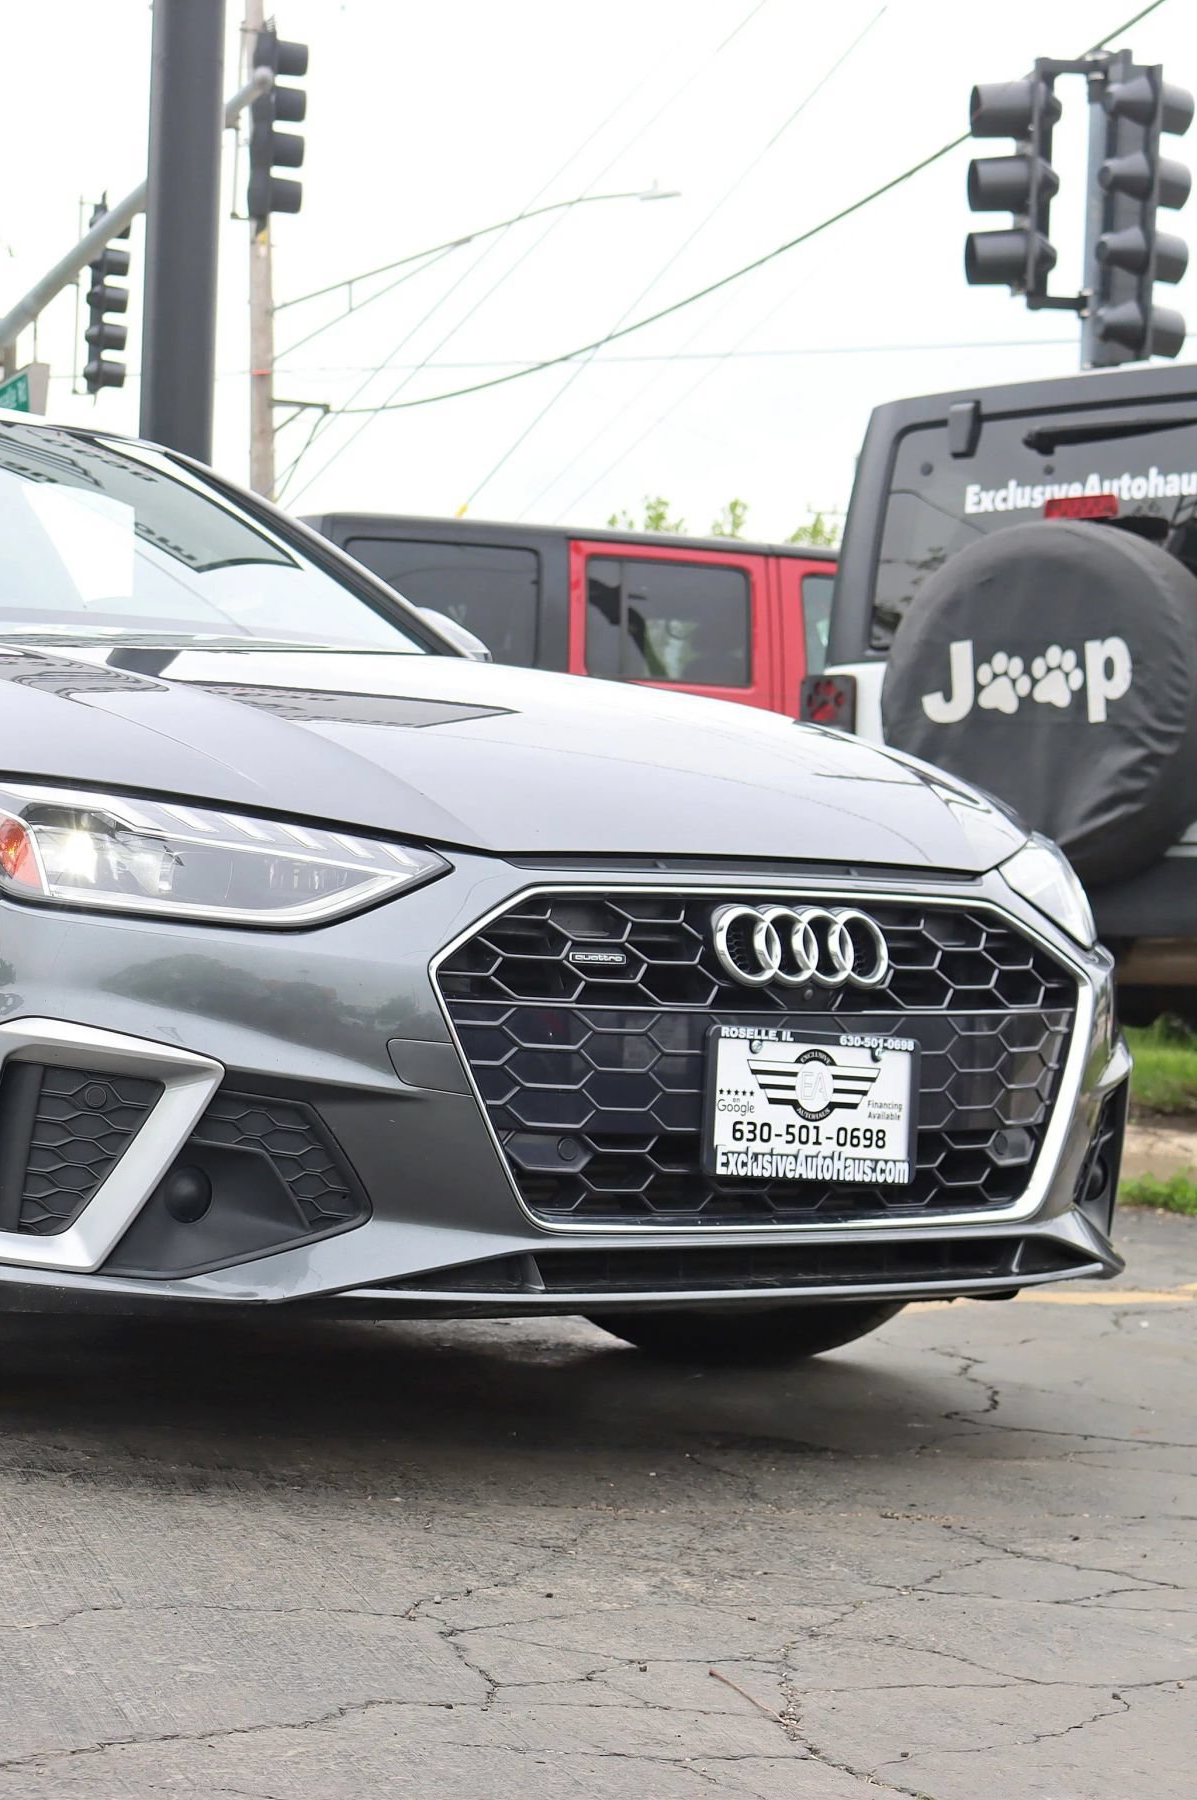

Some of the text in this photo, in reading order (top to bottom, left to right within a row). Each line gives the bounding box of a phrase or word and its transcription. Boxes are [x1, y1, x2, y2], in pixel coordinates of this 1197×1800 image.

[574, 954, 623, 962] quattro
[781, 1030, 795, 1042] IL
[839, 1035, 915, 1051] 630-501-0698
[717, 1098, 755, 1117] Google
[867, 1100, 903, 1112] Financing
[868, 1111, 901, 1121] Available
[732, 1121, 887, 1149] 630-501-0698
[715, 1148, 910, 1184] ExclusiveAutoHaus.com
